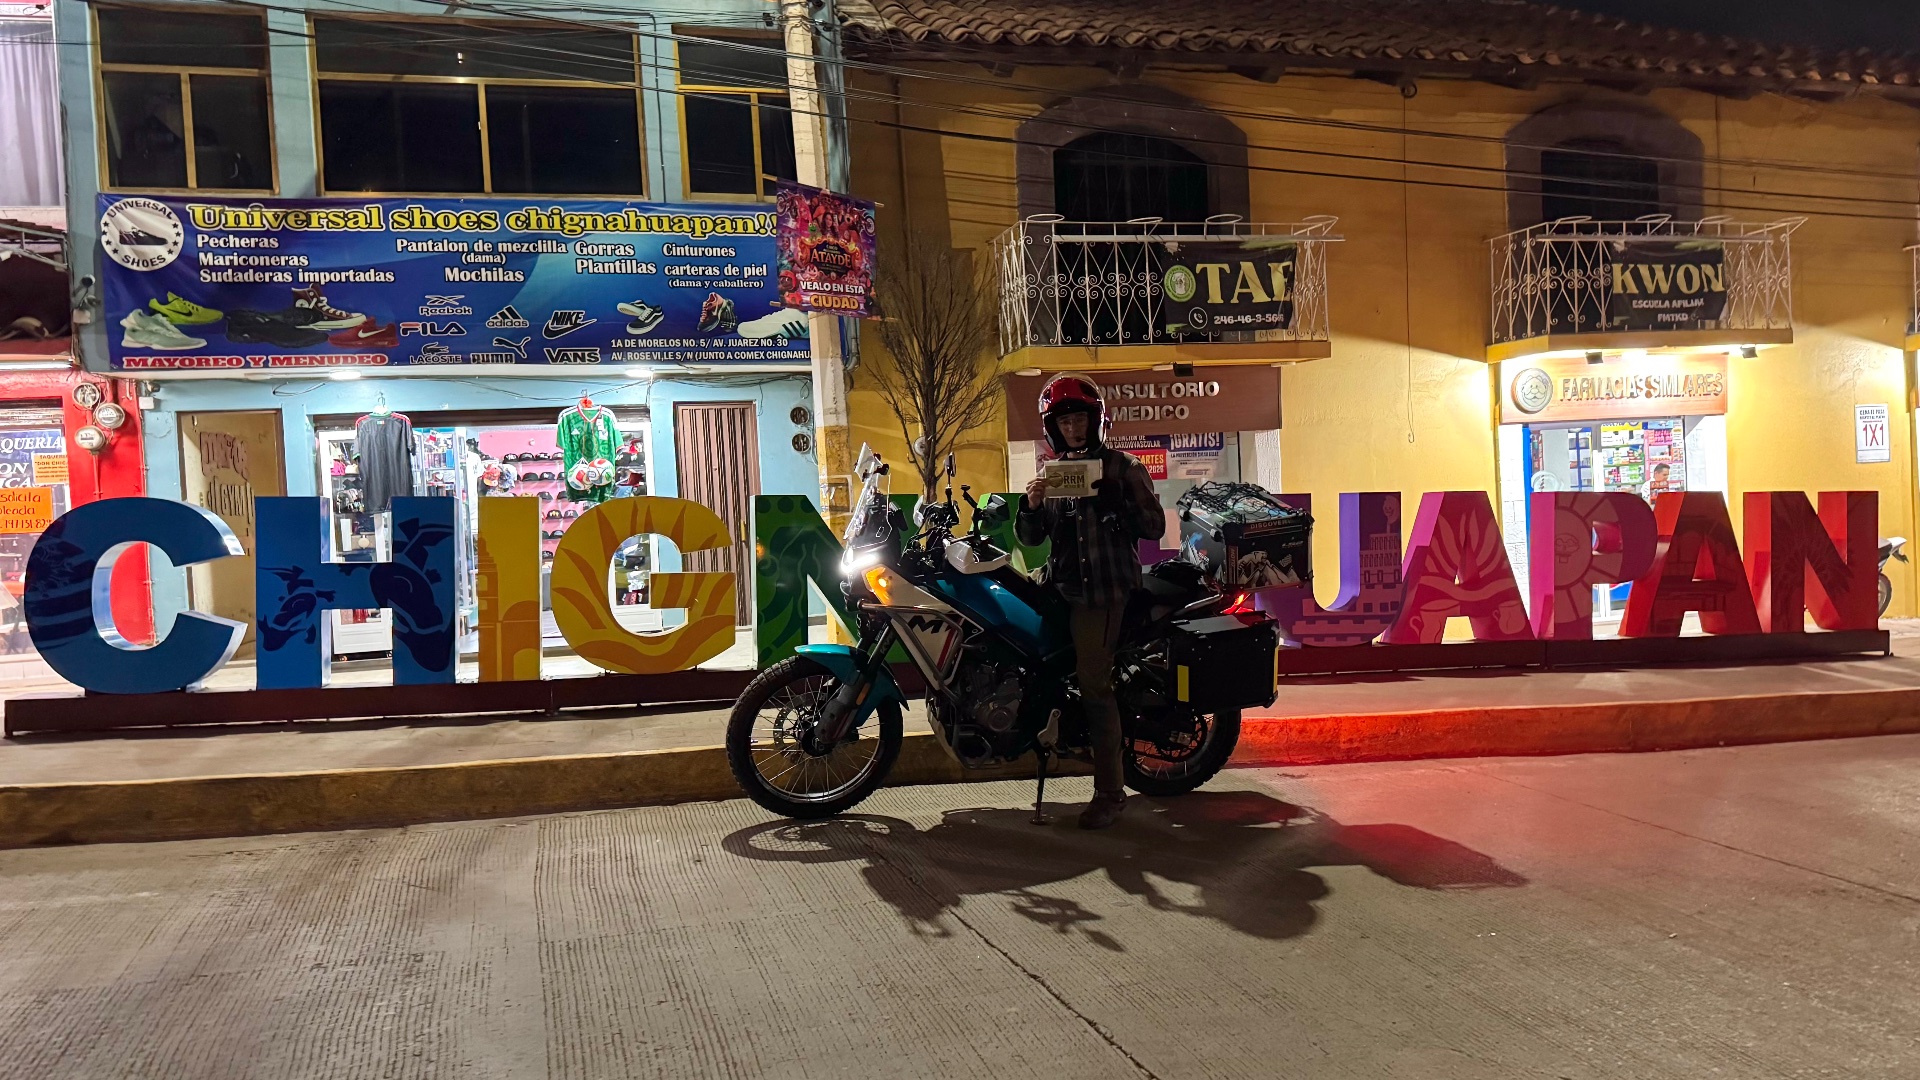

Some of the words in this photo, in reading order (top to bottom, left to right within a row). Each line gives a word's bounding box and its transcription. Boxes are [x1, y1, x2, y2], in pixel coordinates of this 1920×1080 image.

[107, 200, 173, 219] UNIVERSAL
[186, 204, 385, 231] Universal
[389, 205, 499, 233] shoes
[197, 233, 279, 249] Pecheras
[396, 238, 469, 254] Pantalon
[473, 239, 493, 254] de
[497, 239, 567, 255] mezclilla
[575, 240, 635, 257] Gorras
[461, 252, 506, 265] (dama)
[663, 243, 736, 258] Cinturones
[811, 249, 853, 268] ATAYDE
[122, 254, 166, 268] SHOES
[199, 252, 309, 268] Mariconeras
[576, 258, 657, 275] Plantillas
[199, 269, 293, 284] Sudaderas
[298, 269, 394, 286] importadas
[444, 267, 525, 283] Mochilas
[664, 264, 720, 278] carteras
[723, 262, 739, 276] de
[743, 262, 768, 279] piel
[1611, 263, 1725, 294] KWON
[668, 278, 701, 289] (dama
[703, 280, 711, 290] y
[713, 278, 764, 289] caballero)
[800, 281, 831, 291] VEALO
[832, 283, 844, 292] EN
[845, 284, 865, 294] ESTA
[810, 294, 859, 309] CIUDAD
[1632, 299, 1670, 309] ESCUELA
[419, 306, 472, 316] Reebok
[550, 310, 586, 327] NIKE
[400, 322, 467, 337] FILA
[486, 319, 529, 328] adidas
[611, 338, 623, 348] 1A
[625, 338, 637, 348] DE
[638, 338, 681, 348] MORELOS
[683, 338, 699, 348] NO.
[713, 338, 727, 348] AV.
[728, 338, 759, 348] JUAREZ
[760, 338, 775, 348] NO.
[776, 338, 788, 348] 30
[123, 355, 245, 369] MAYOREO
[247, 355, 266, 368] Y
[268, 353, 388, 368] MENUDEO
[410, 354, 462, 365] LACOSTE
[544, 348, 601, 364] VANS
[695, 350, 725, 361] (JUNTO
[726, 350, 733, 359] A
[734, 350, 764, 360] COMEX
[766, 349, 811, 359] CHIGNAHU
[1101, 381, 1219, 400] NSULTORIO
[1111, 405, 1189, 421] MEDICO
[0, 437, 63, 453] QUERIA
[0, 463, 29, 475] ON
[1063, 475, 1085, 484] RRM
